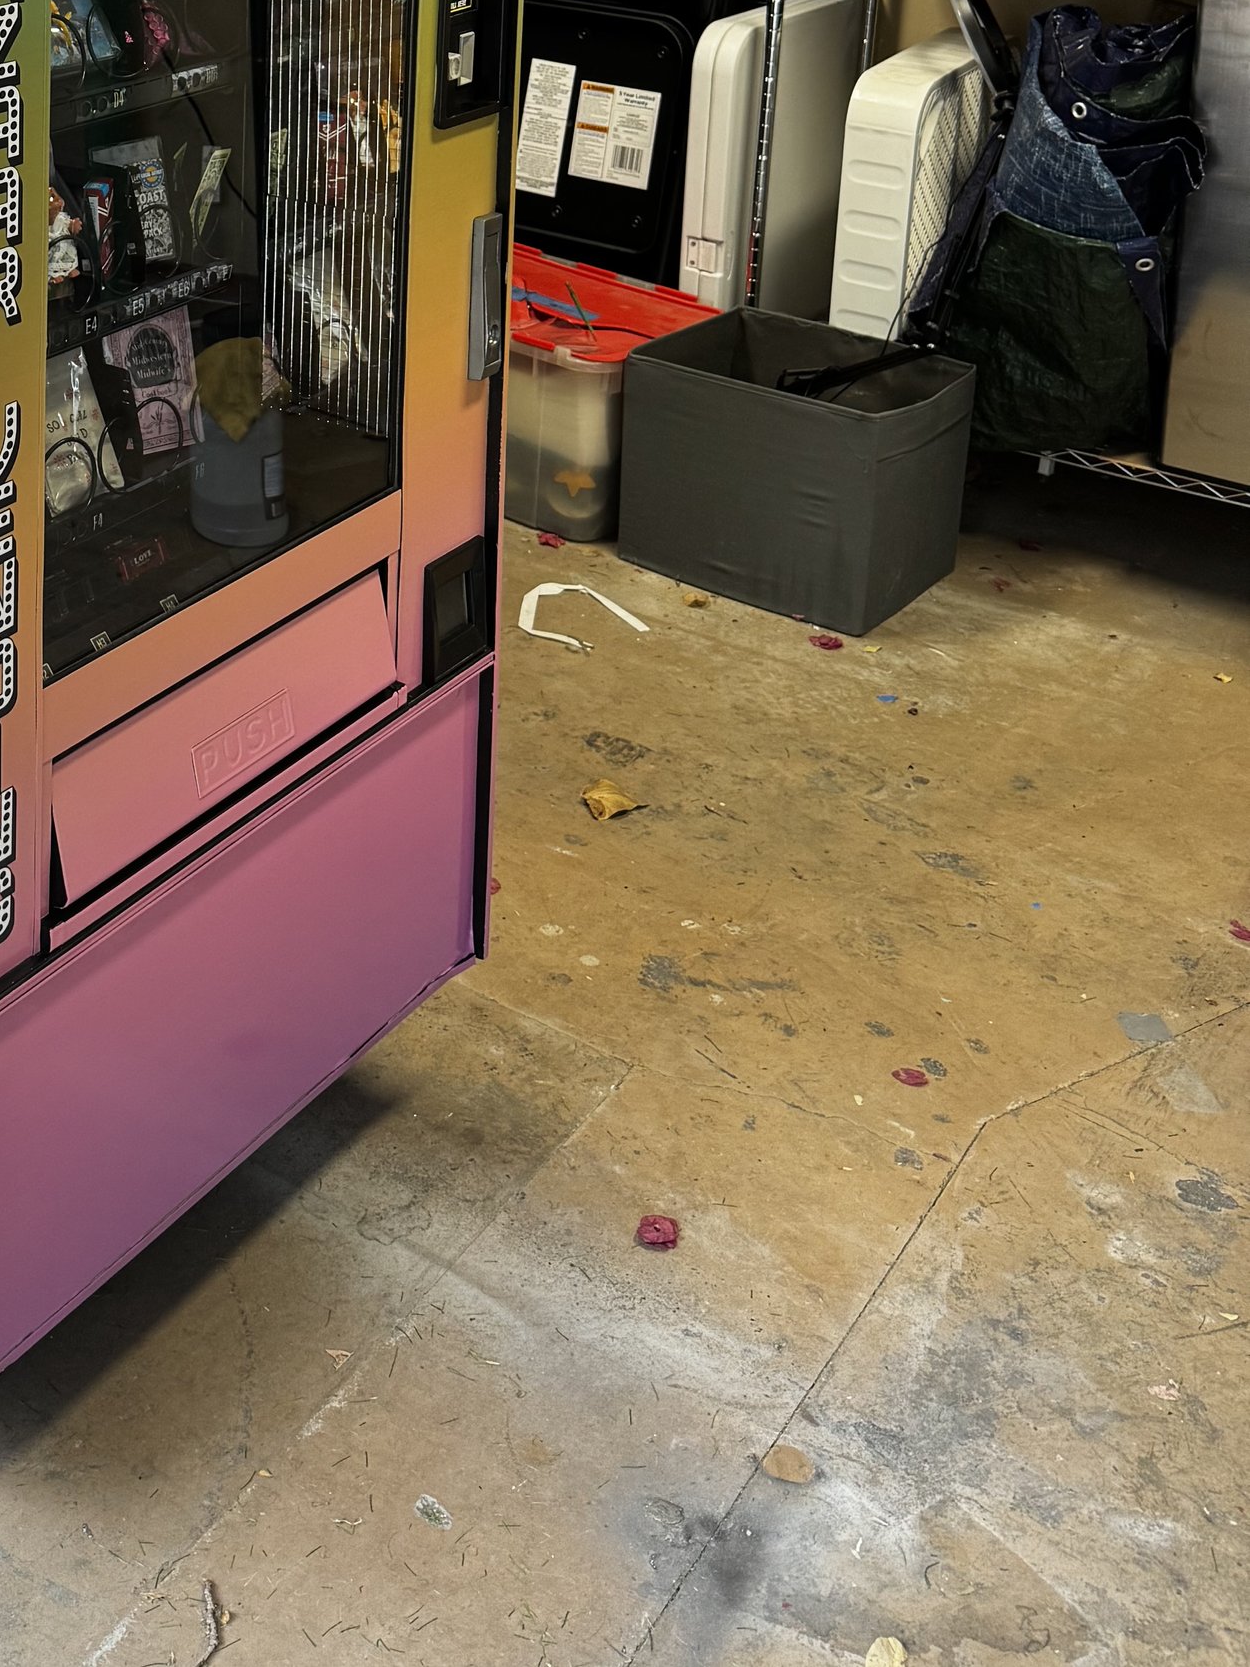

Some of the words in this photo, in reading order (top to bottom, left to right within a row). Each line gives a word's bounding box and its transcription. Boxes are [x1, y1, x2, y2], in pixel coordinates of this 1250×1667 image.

[132, 296, 145, 316] E5
[85, 316, 98, 335] E4
[201, 700, 291, 783] PUSH
